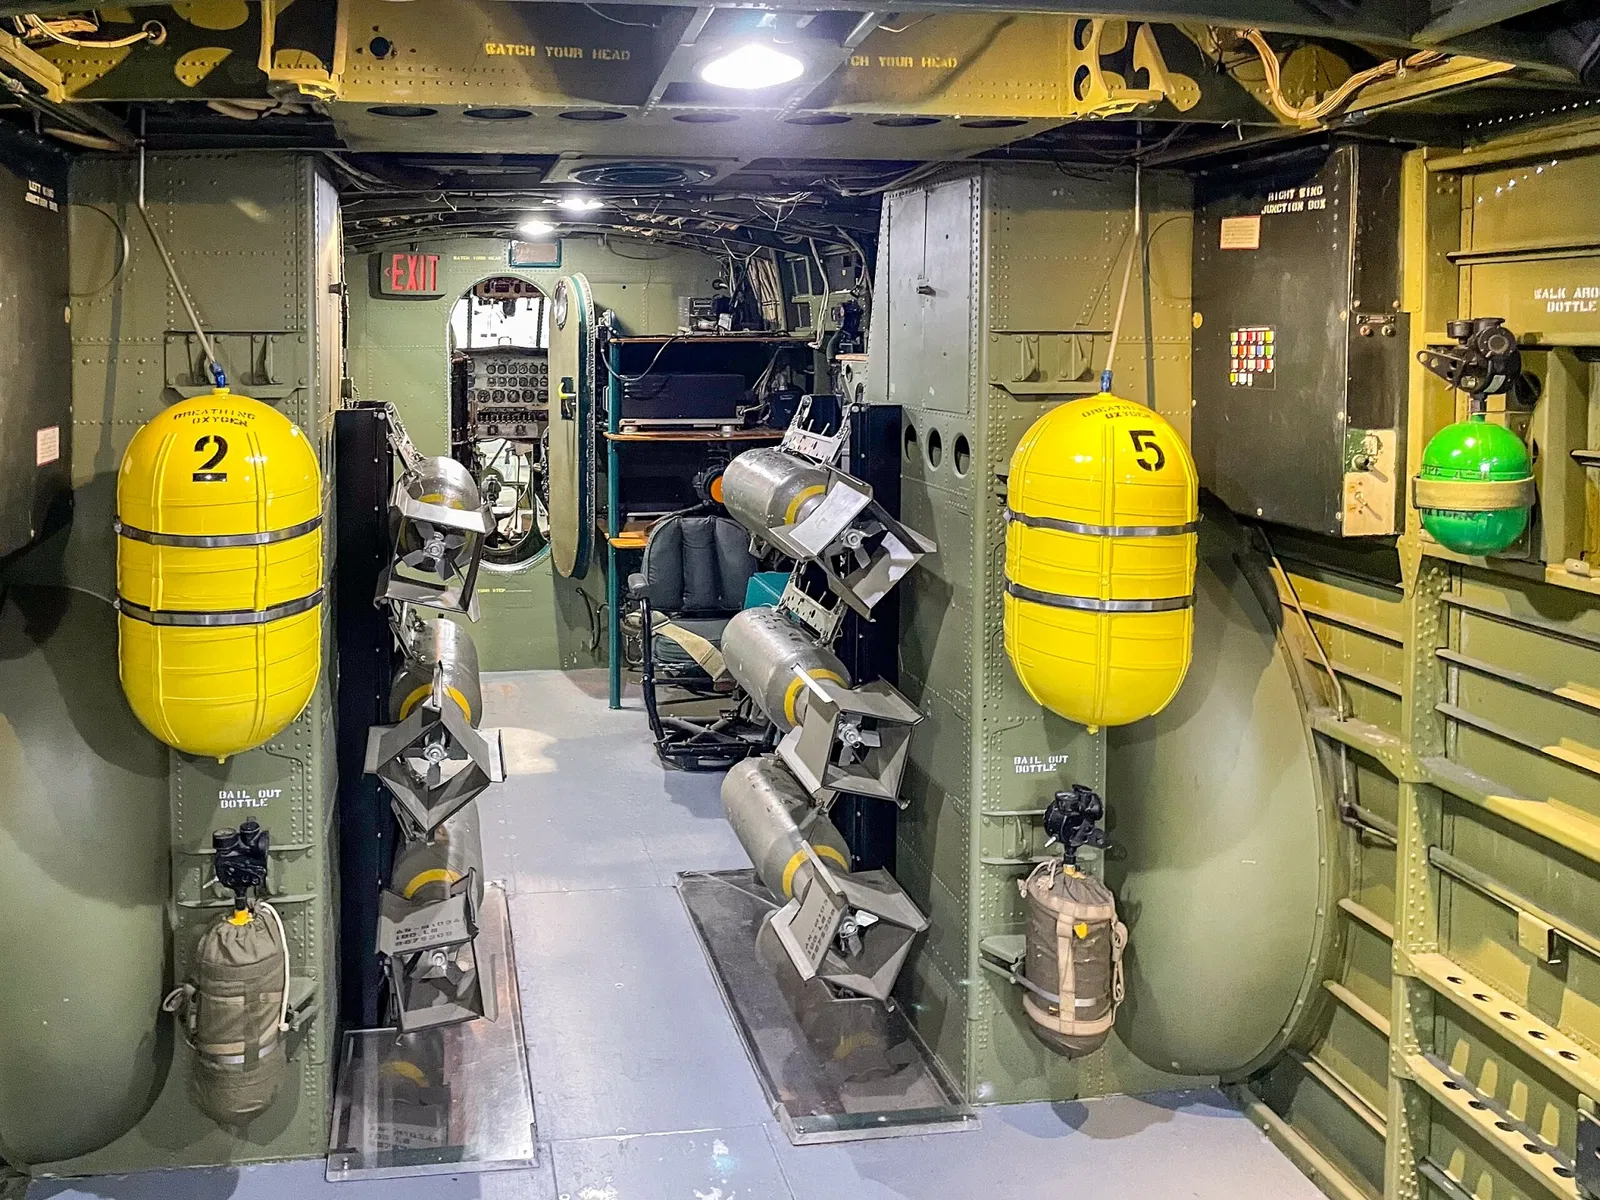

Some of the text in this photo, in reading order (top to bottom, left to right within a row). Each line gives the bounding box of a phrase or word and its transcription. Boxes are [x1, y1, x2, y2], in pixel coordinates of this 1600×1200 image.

[485, 43, 631, 60] WATCH YOUR HEAD
[878, 56, 914, 67] YOUR
[921, 57, 957, 68] HEAD
[1268, 185, 1323, 202] RIGHT WING
[1261, 198, 1326, 215] JUNCTION BOX
[391, 254, 440, 292] EXIT
[1533, 287, 1566, 299] WALK
[1547, 300, 1597, 312] BOTTLE
[173, 408, 256, 420] BREATHING
[192, 416, 248, 427] OXYGEN
[1128, 429, 1166, 472] 5
[192, 435, 228, 482] 2
[1014, 755, 1069, 764] BAIL OUT
[1015, 763, 1057, 773] BOTTLE
[218, 789, 282, 799] BAIL OUT
[220, 798, 269, 808] BOTTLE
